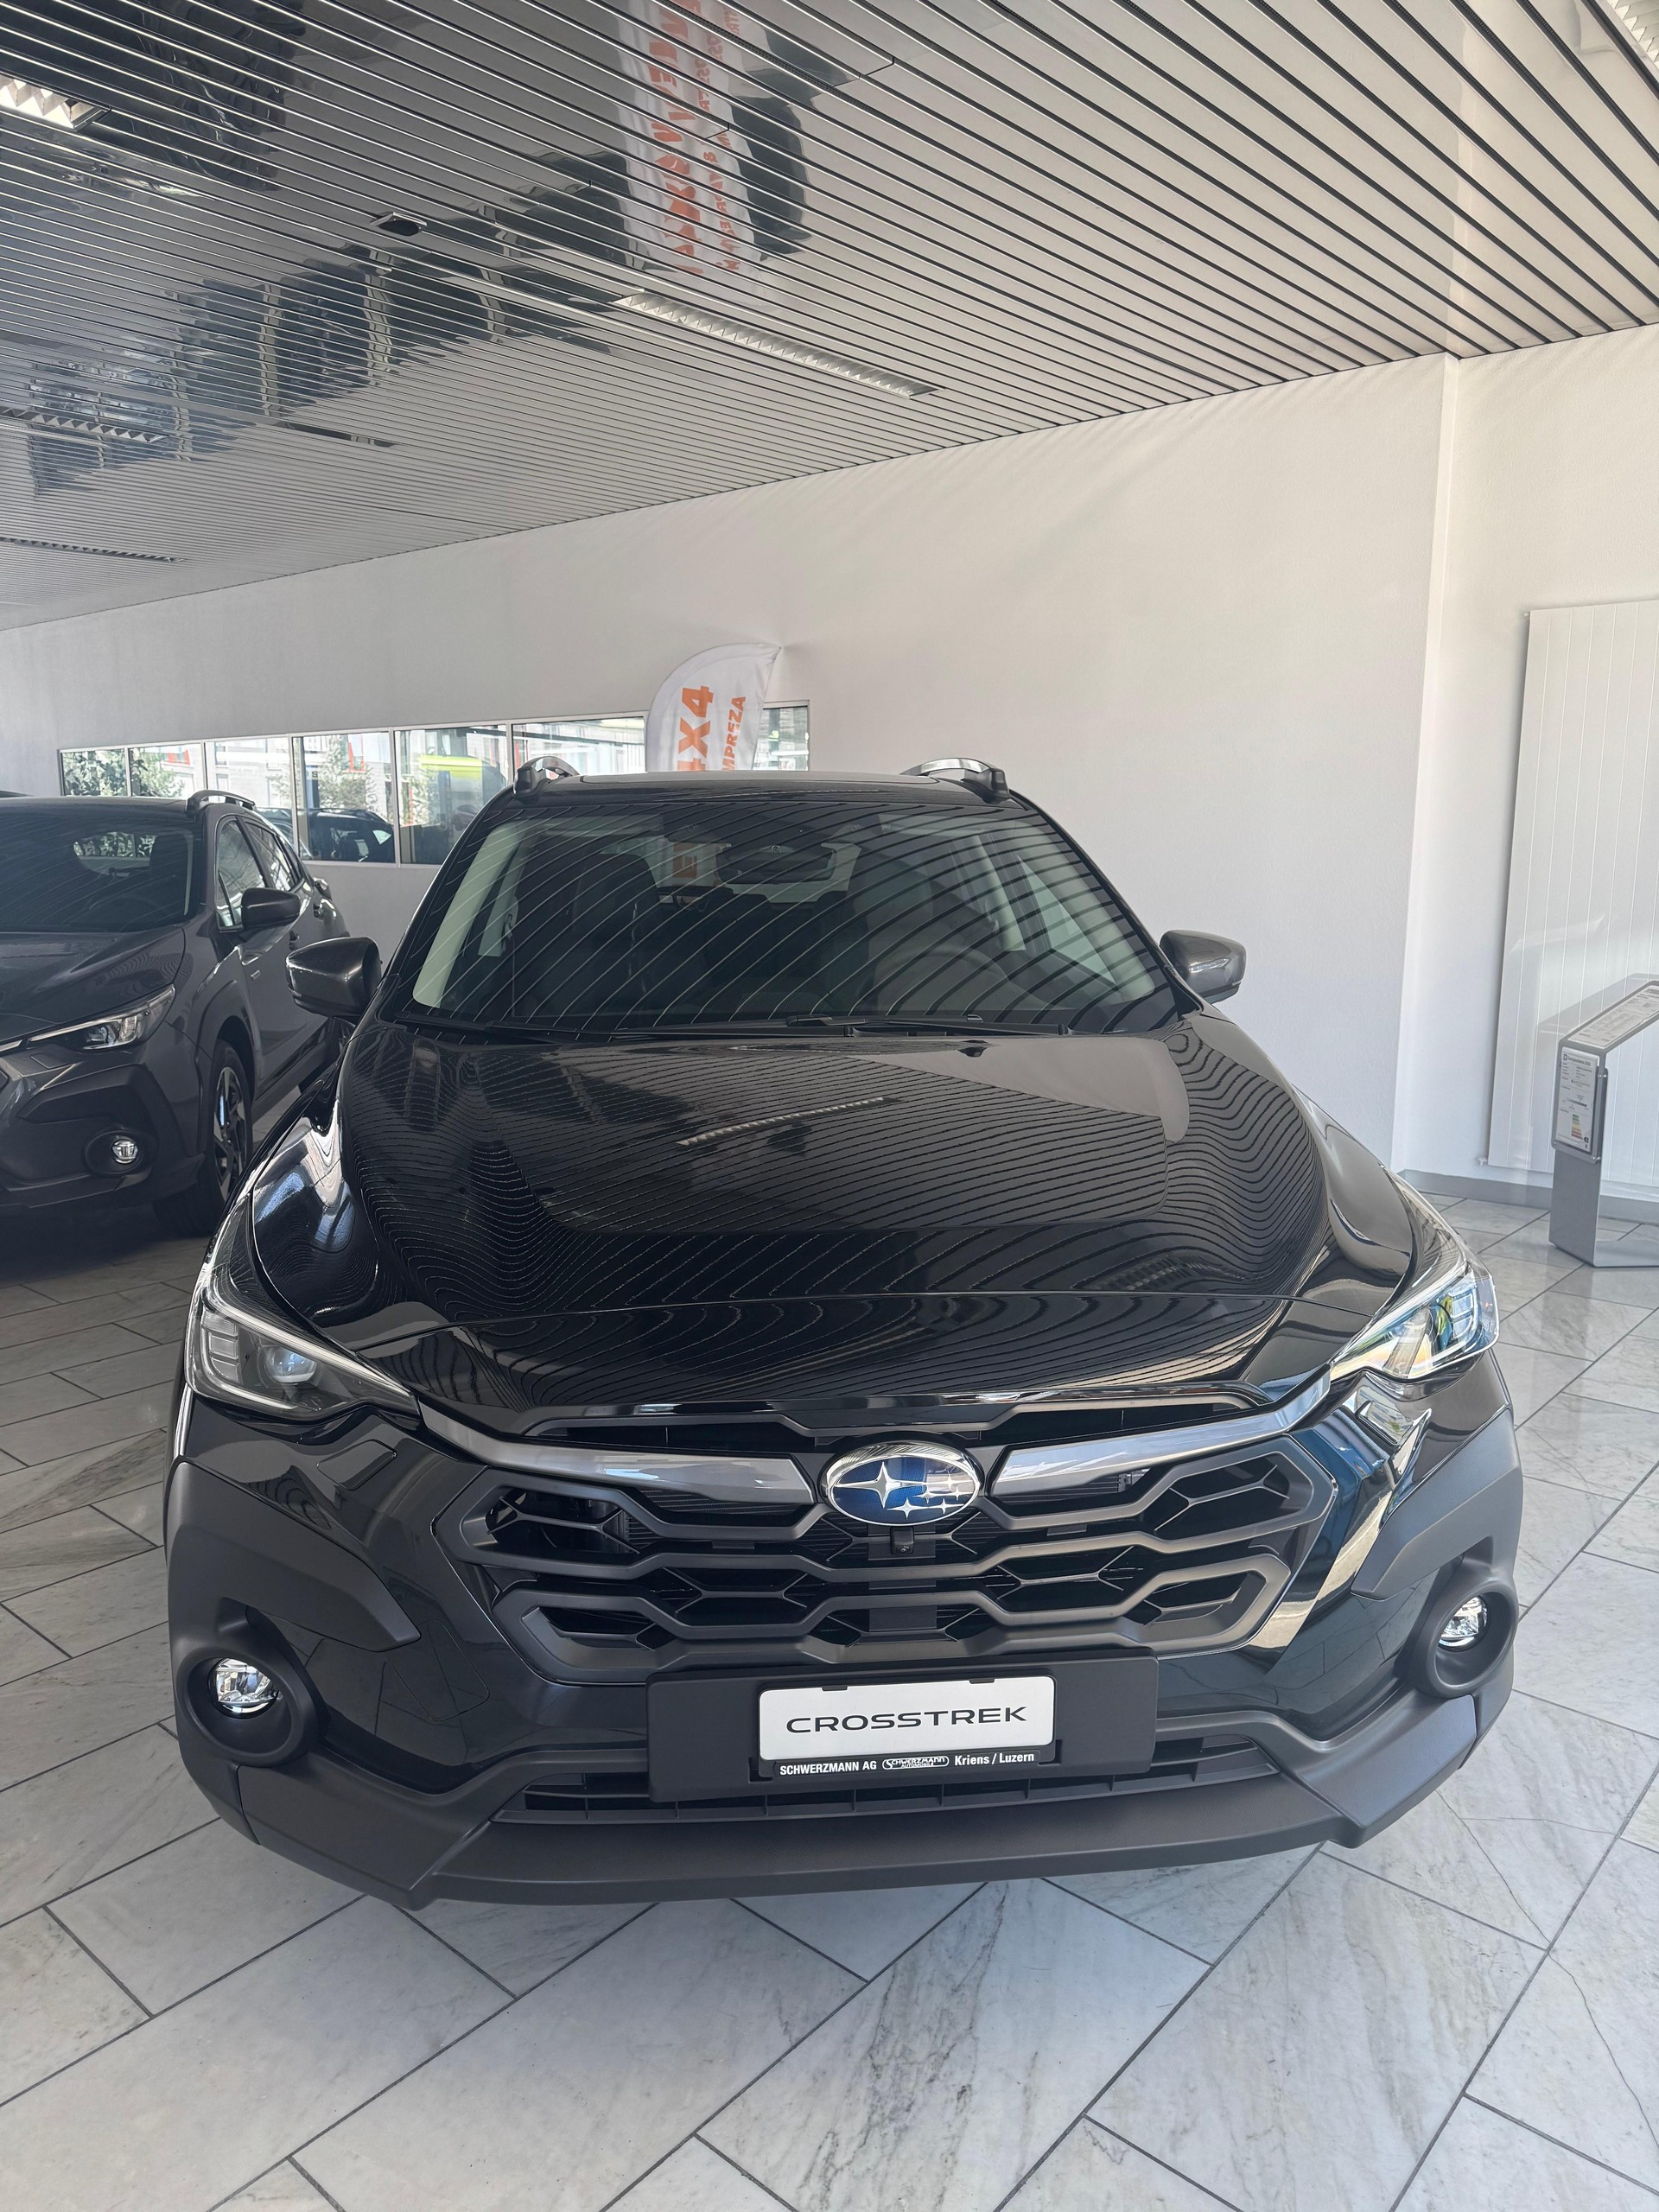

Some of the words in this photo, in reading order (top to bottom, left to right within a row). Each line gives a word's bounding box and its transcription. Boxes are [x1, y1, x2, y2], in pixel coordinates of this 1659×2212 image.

[721, 696, 747, 771] MPREZA
[786, 1707, 1027, 1733] CROSSTREK
[779, 1761, 859, 1776] SCHWERZMANN
[862, 1760, 877, 1770] AG
[954, 1754, 990, 1766] Kriens
[991, 1752, 997, 1765] /
[999, 1752, 1035, 1764] Luzern
